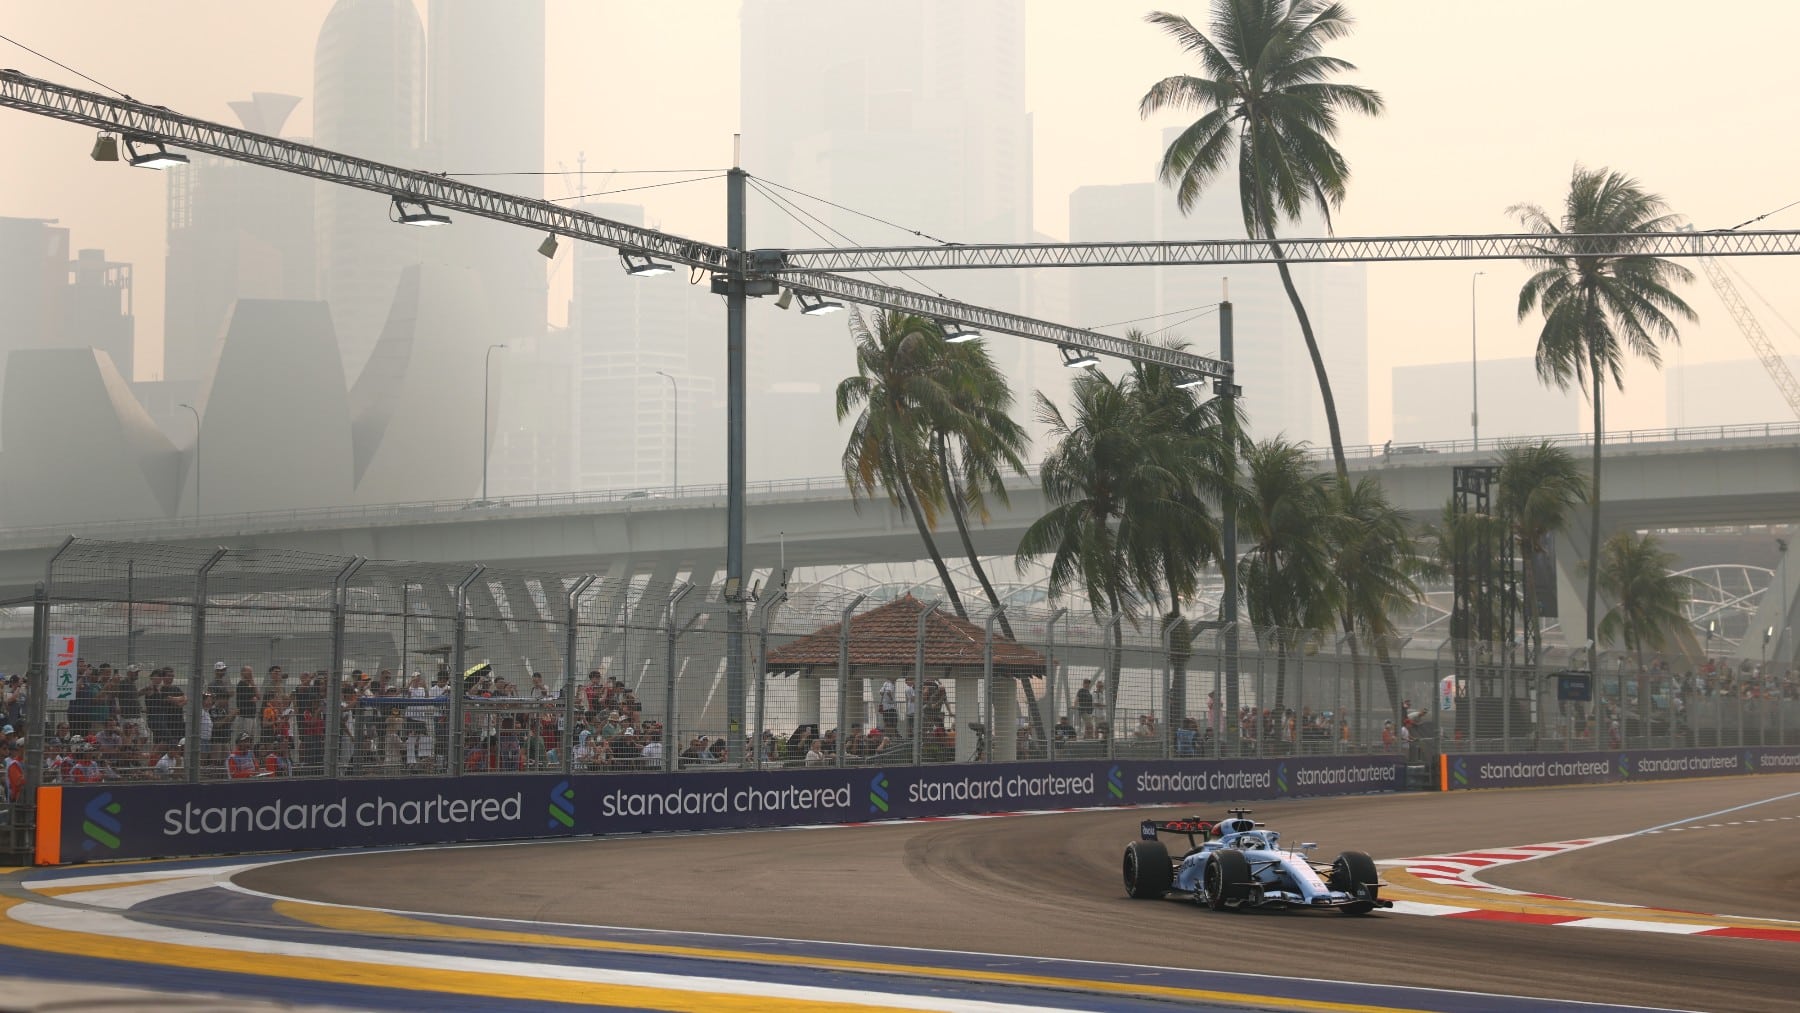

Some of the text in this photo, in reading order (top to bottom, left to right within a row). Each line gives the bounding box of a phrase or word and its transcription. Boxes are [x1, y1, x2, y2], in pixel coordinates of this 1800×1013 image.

[1480, 759, 1610, 779] standard chartered
[1637, 754, 1738, 772] standard chartered
[1136, 769, 1271, 792] standard chartered
[1296, 764, 1396, 786] standard chartered
[908, 772, 1094, 803] standard chartered
[602, 783, 851, 817] standard chartered
[163, 791, 522, 836] standard chartered
